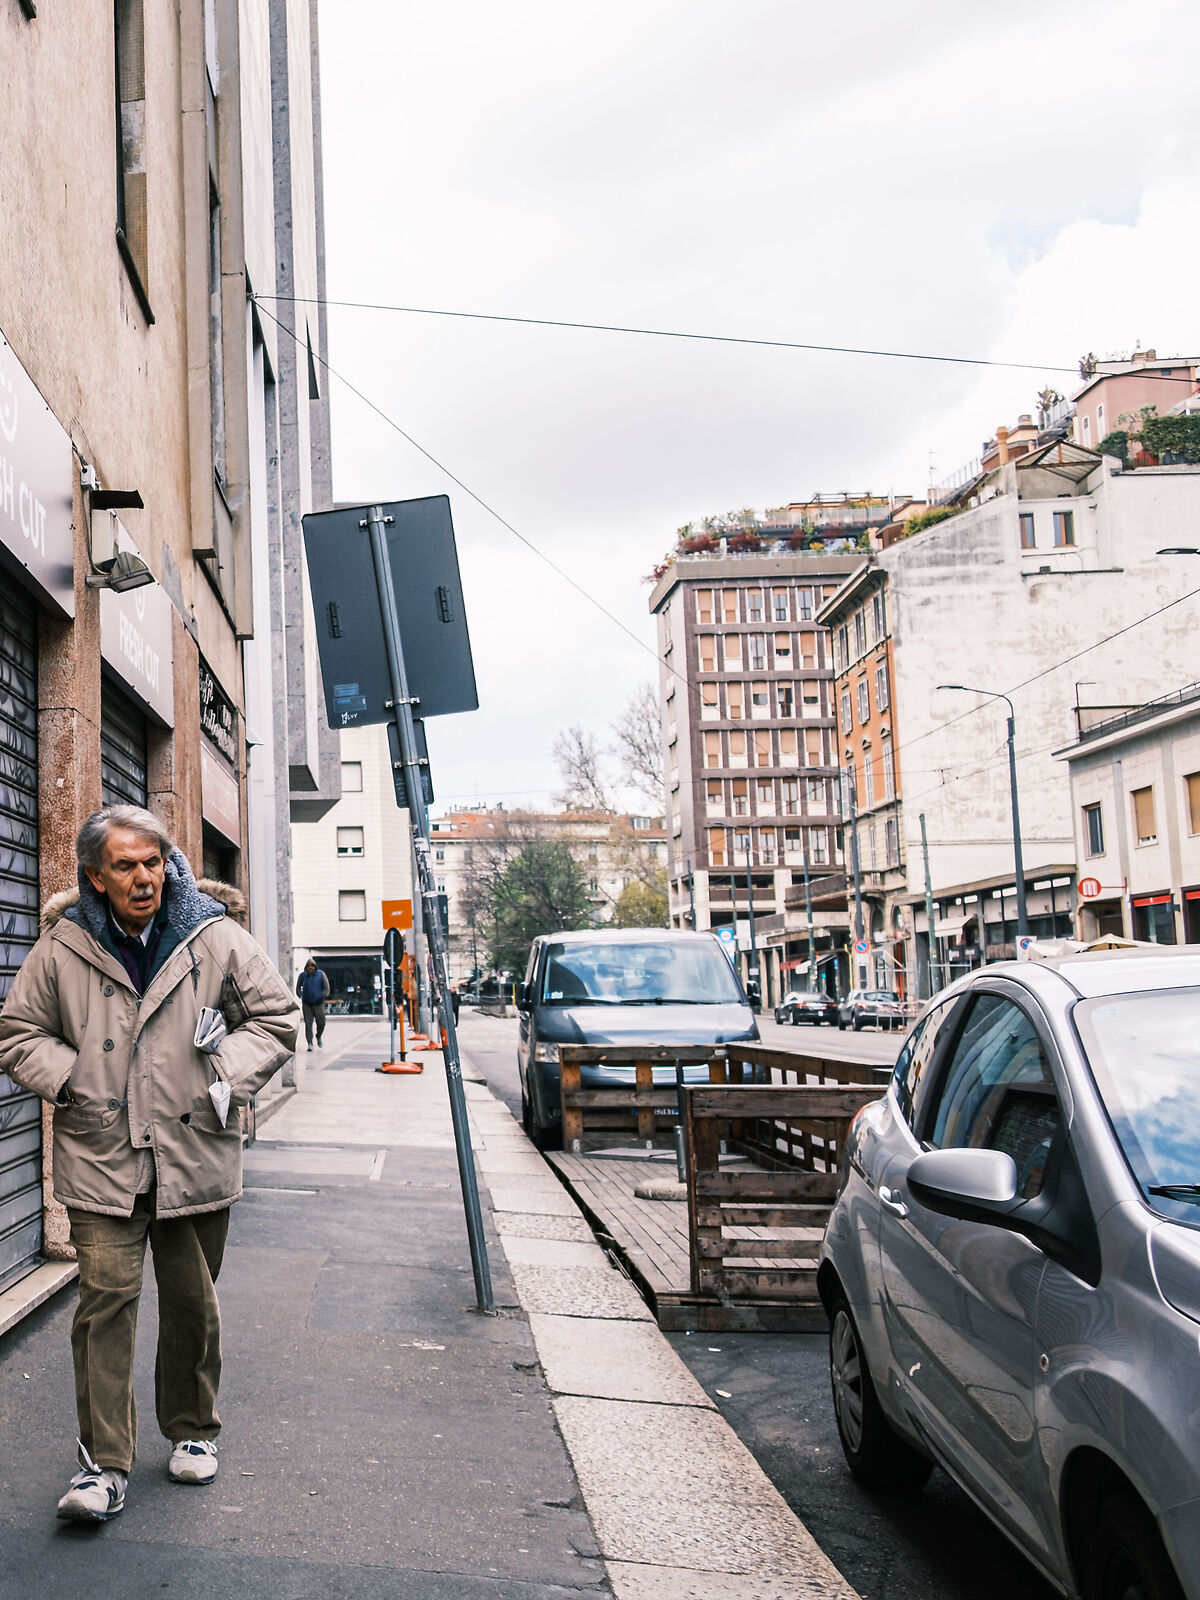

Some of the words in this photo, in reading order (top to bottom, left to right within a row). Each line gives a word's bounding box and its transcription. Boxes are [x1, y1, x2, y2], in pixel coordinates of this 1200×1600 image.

[19, 480, 47, 557] CUT
[119, 609, 144, 676] FRESH
[145, 644, 160, 693] CUT
